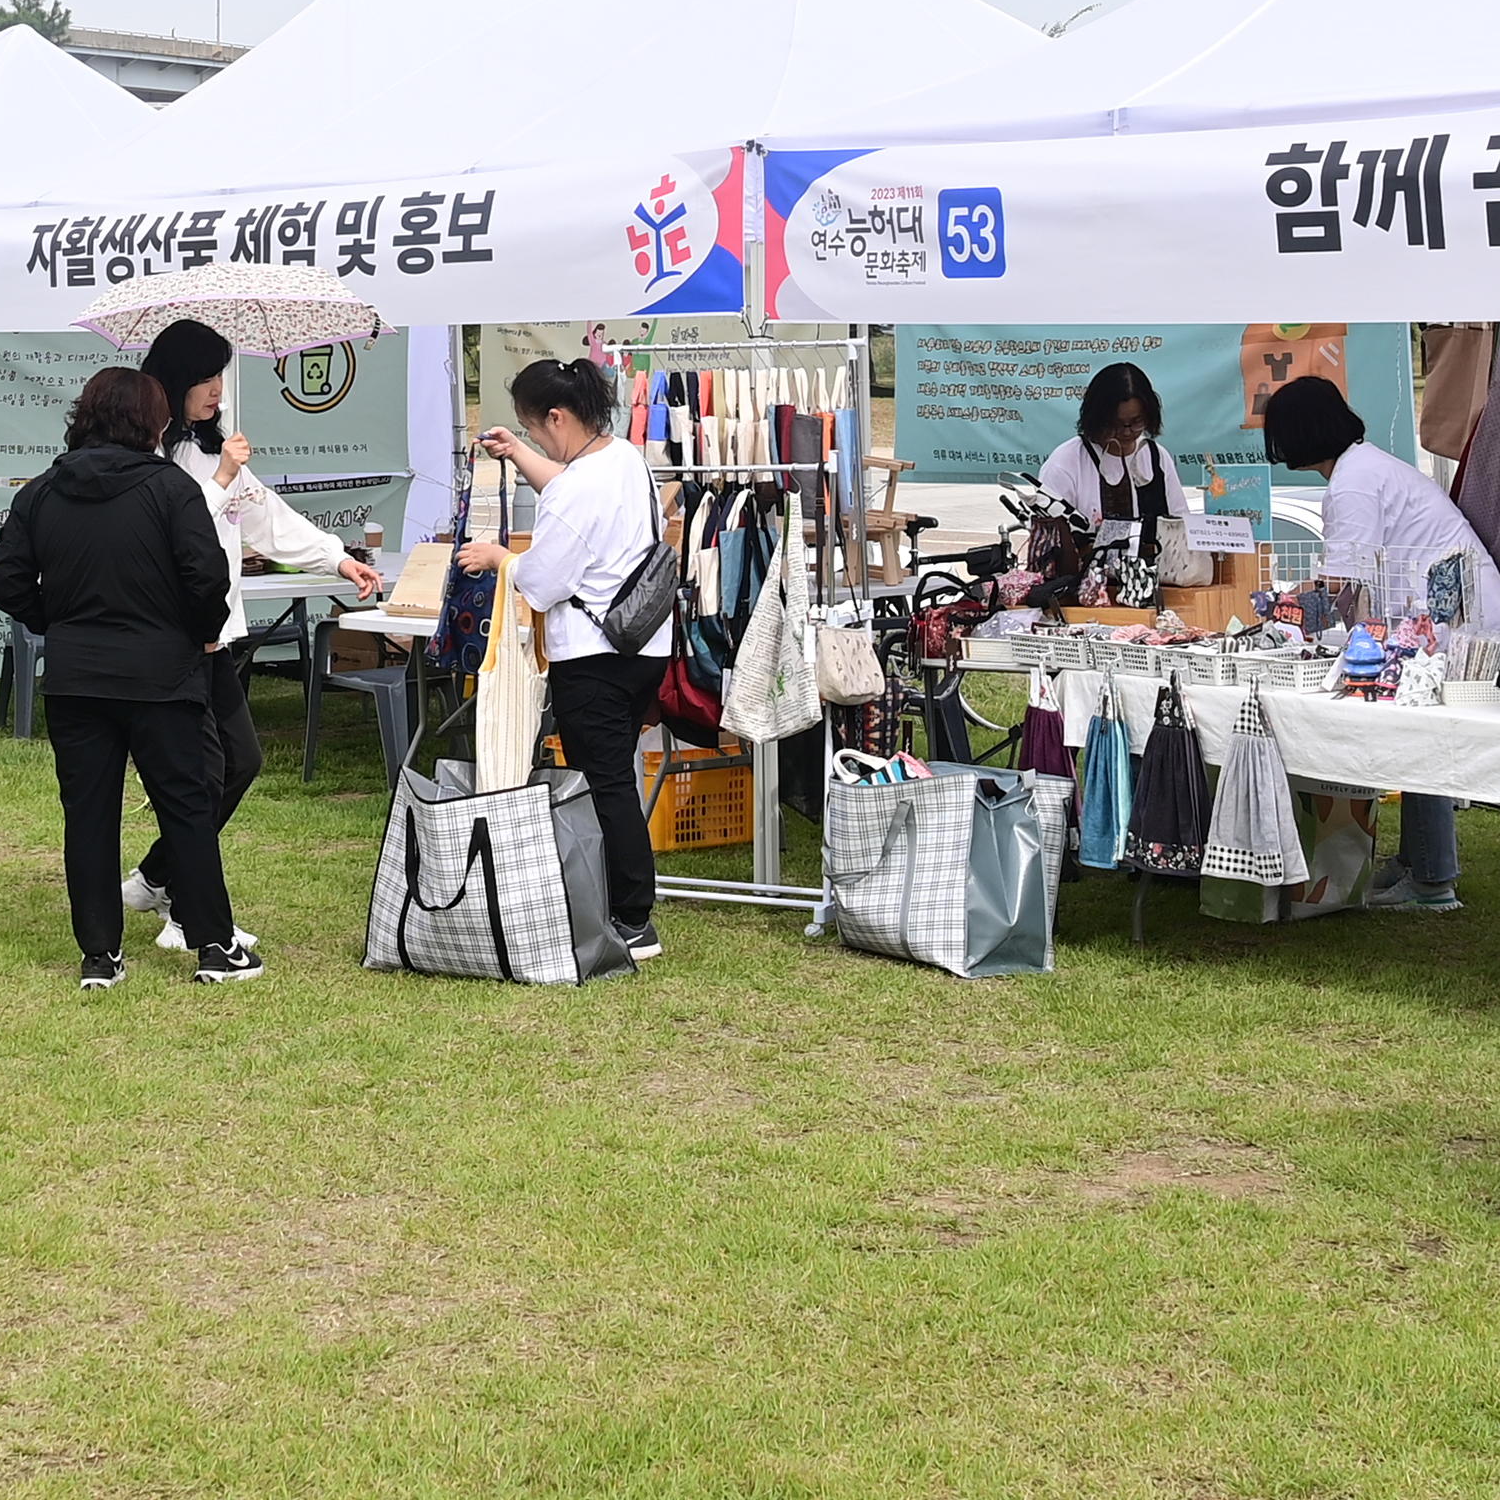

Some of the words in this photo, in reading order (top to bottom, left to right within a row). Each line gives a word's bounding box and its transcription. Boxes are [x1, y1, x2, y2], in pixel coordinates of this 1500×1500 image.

[871, 187, 895, 200] 2023
[897, 186, 924, 200] 제11회
[1265, 133, 1451, 254] 함께
[26, 209, 219, 288] 자활생산품
[230, 202, 324, 269] 체험
[334, 194, 386, 277] 및
[393, 189, 498, 275] 홍보
[811, 230, 846, 261] 연수
[846, 205, 924, 257] 능허대
[948, 204, 996, 263] 53
[865, 250, 926, 278] 문화축제
[25, 351, 63, 365] 재활용과
[68, 353, 108, 364] 디자인과
[114, 352, 142, 366] 가치를
[31, 394, 63, 407] 만들어
[352, 443, 368, 453] 수거
[933, 449, 947, 460] 의류
[948, 450, 963, 462] 대여
[964, 451, 986, 462] 서비스
[992, 452, 1007, 464] 중고
[1008, 453, 1023, 464] 의류
[1025, 453, 1041, 465] 판매
[1179, 453, 1214, 465] 폐의류
[1216, 453, 1244, 465] 활용한
[1273, 605, 1303, 625] 4천원
